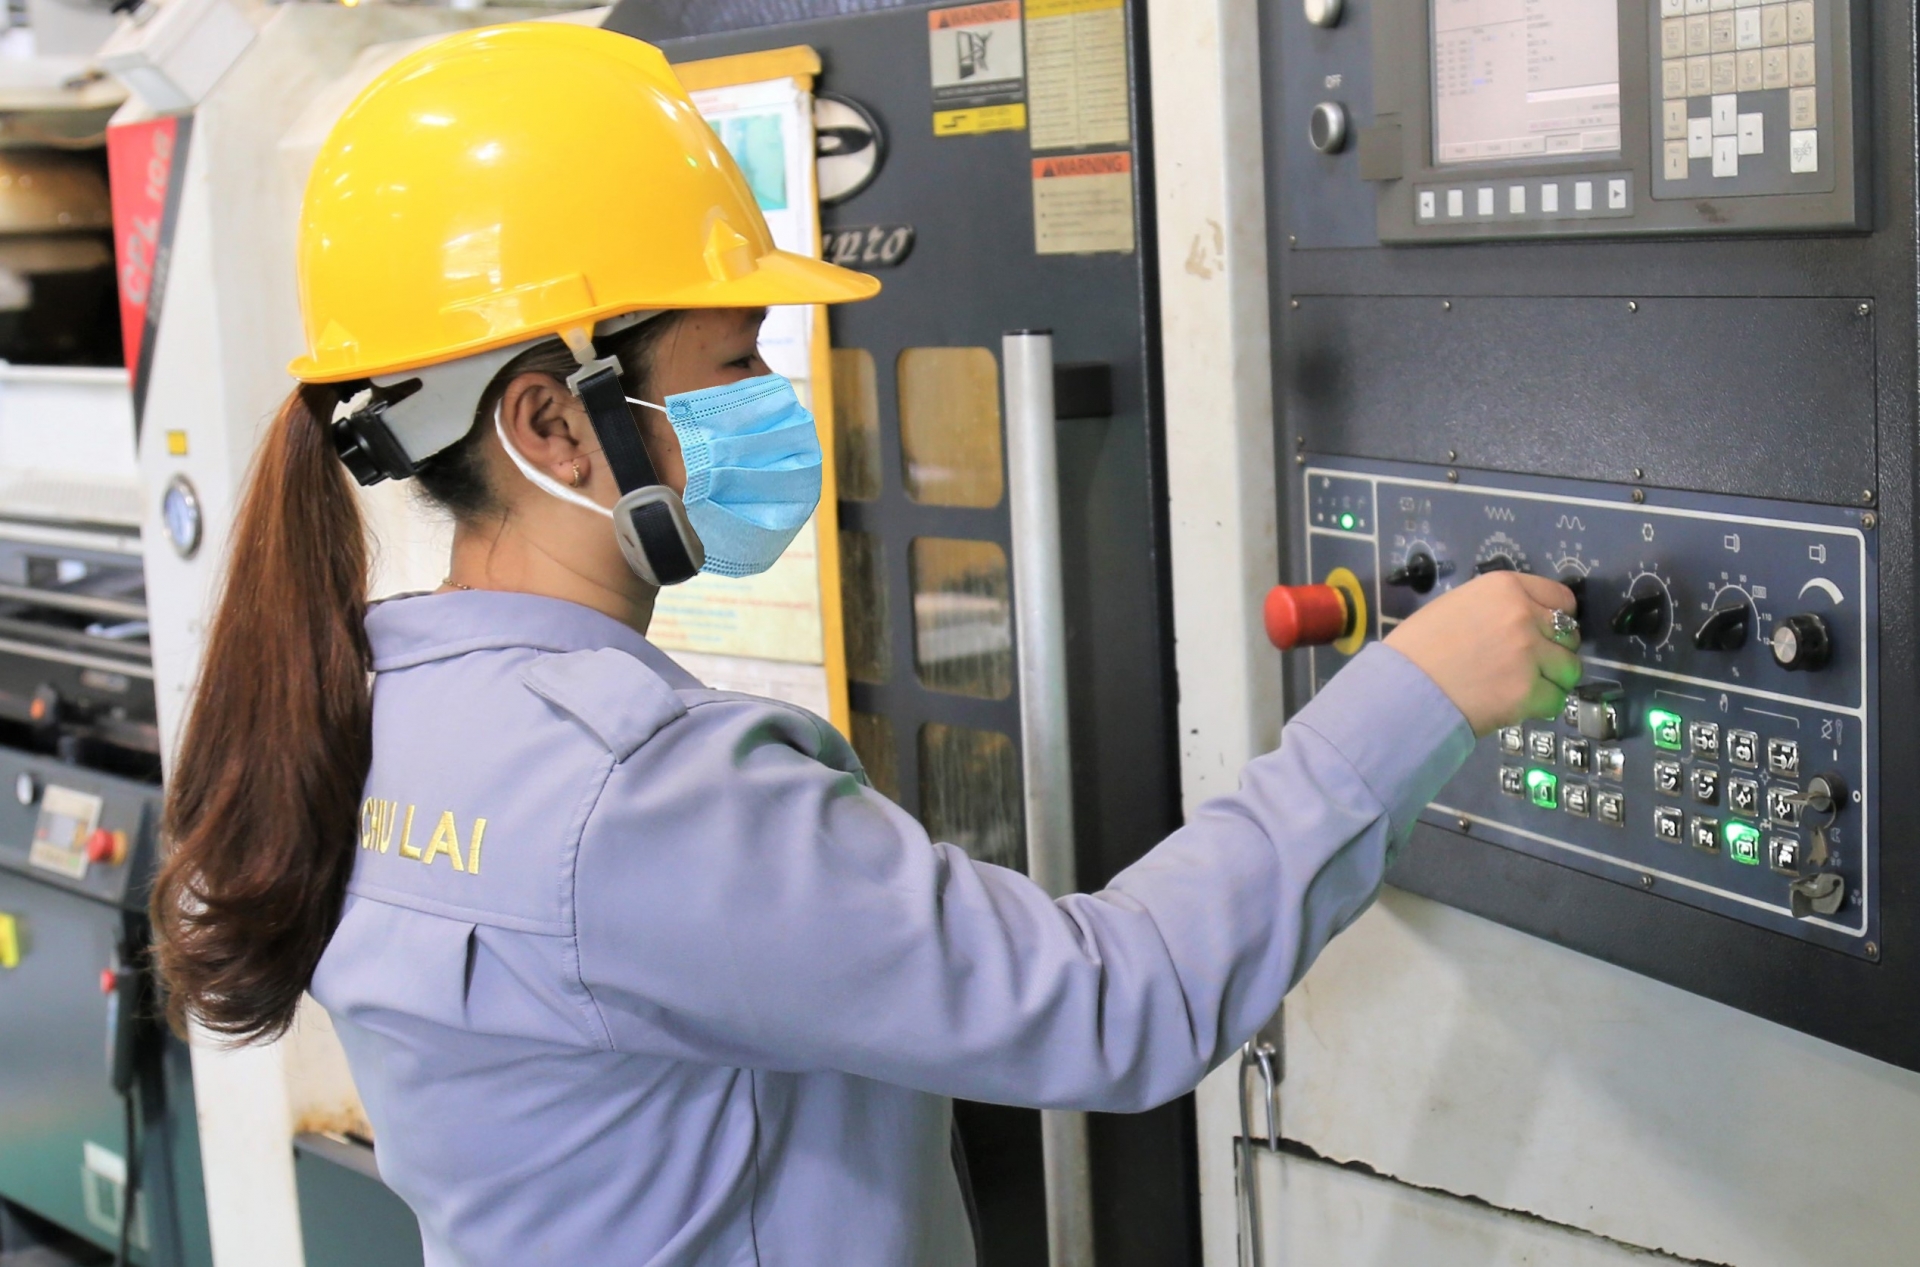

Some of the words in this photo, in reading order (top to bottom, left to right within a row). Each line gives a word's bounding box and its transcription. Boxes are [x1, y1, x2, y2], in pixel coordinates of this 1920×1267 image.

[950, 3, 1012, 26] WARNING
[1325, 74, 1342, 88] OFF
[1056, 155, 1122, 176] WARNING
[1761, 613, 1772, 621] 110
[361, 796, 397, 854] CHU
[398, 804, 487, 875] LAI
[1661, 819, 1676, 836] F3
[1699, 829, 1713, 847] F4
